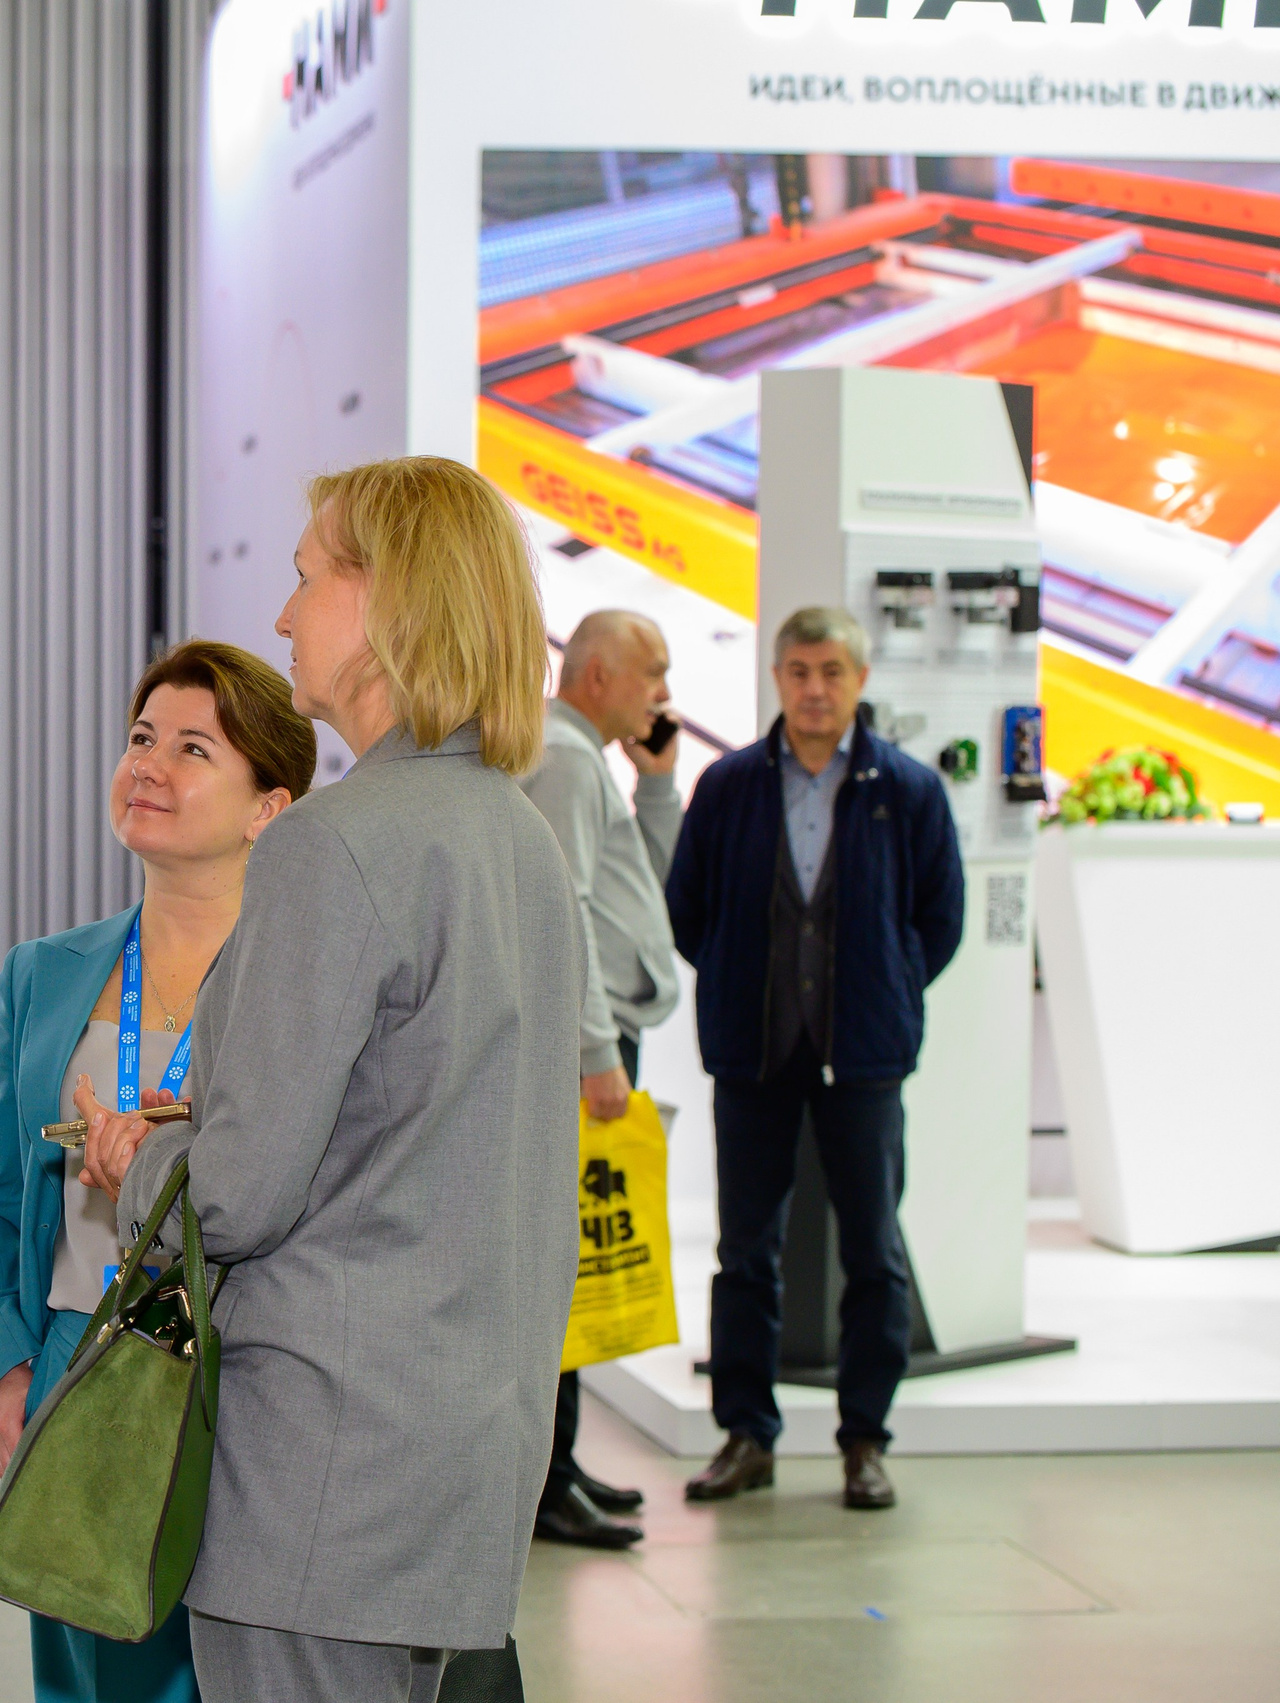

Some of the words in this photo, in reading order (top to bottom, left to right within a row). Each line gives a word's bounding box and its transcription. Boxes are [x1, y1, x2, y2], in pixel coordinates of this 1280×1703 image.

[863, 71, 1148, 107] ВОПЛОЩЁННЫЕ
[1157, 81, 1177, 108] В
[521, 461, 646, 551] GEISS
